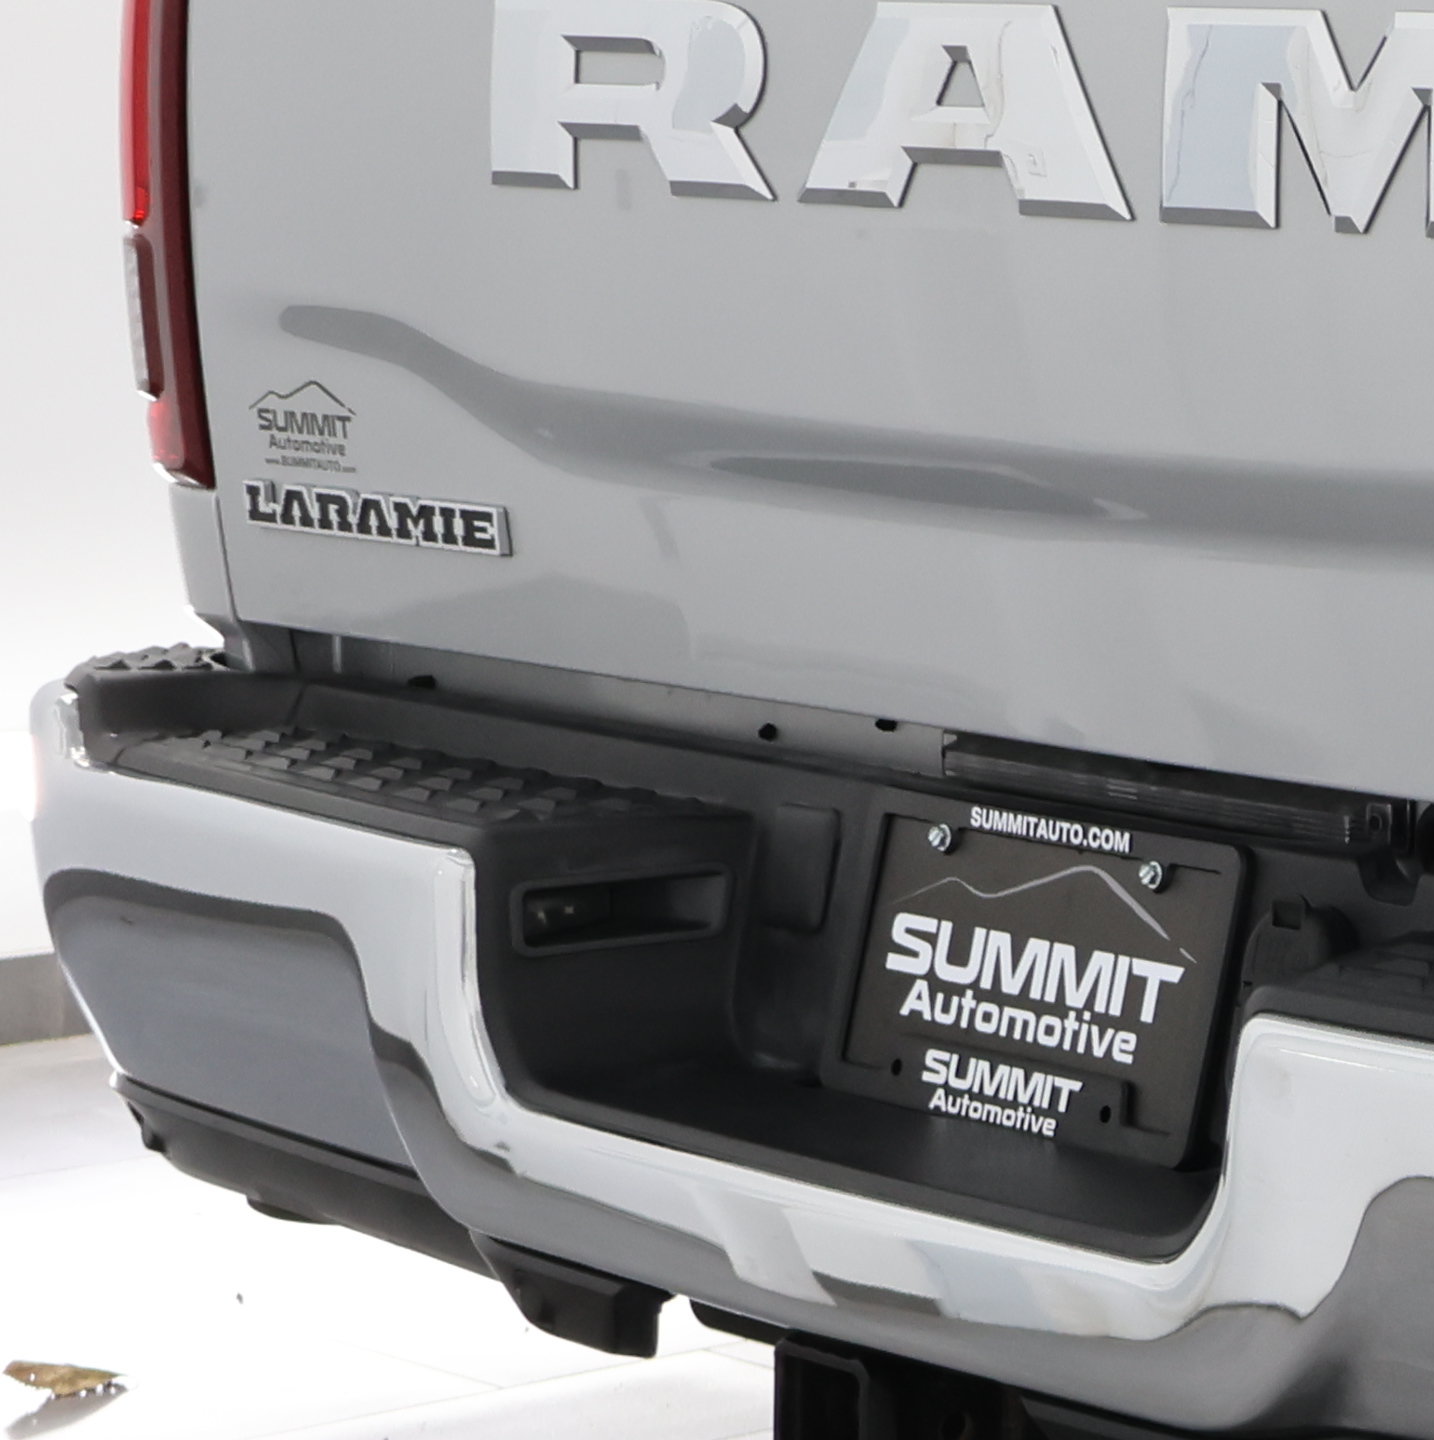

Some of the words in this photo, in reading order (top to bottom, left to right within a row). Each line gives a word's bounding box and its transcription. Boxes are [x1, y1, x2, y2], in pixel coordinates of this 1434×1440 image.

[256, 407, 353, 440] SUMMIT
[268, 433, 347, 458] Automotive
[242, 478, 510, 557] LARAMIE
[969, 806, 1132, 854] SUMMITAUTO.COM
[885, 912, 1186, 1024] SUMMIT
[899, 978, 1138, 1065] Automotive
[921, 1048, 1083, 1114] SUMMIT
[928, 1087, 1058, 1137] Automotive
